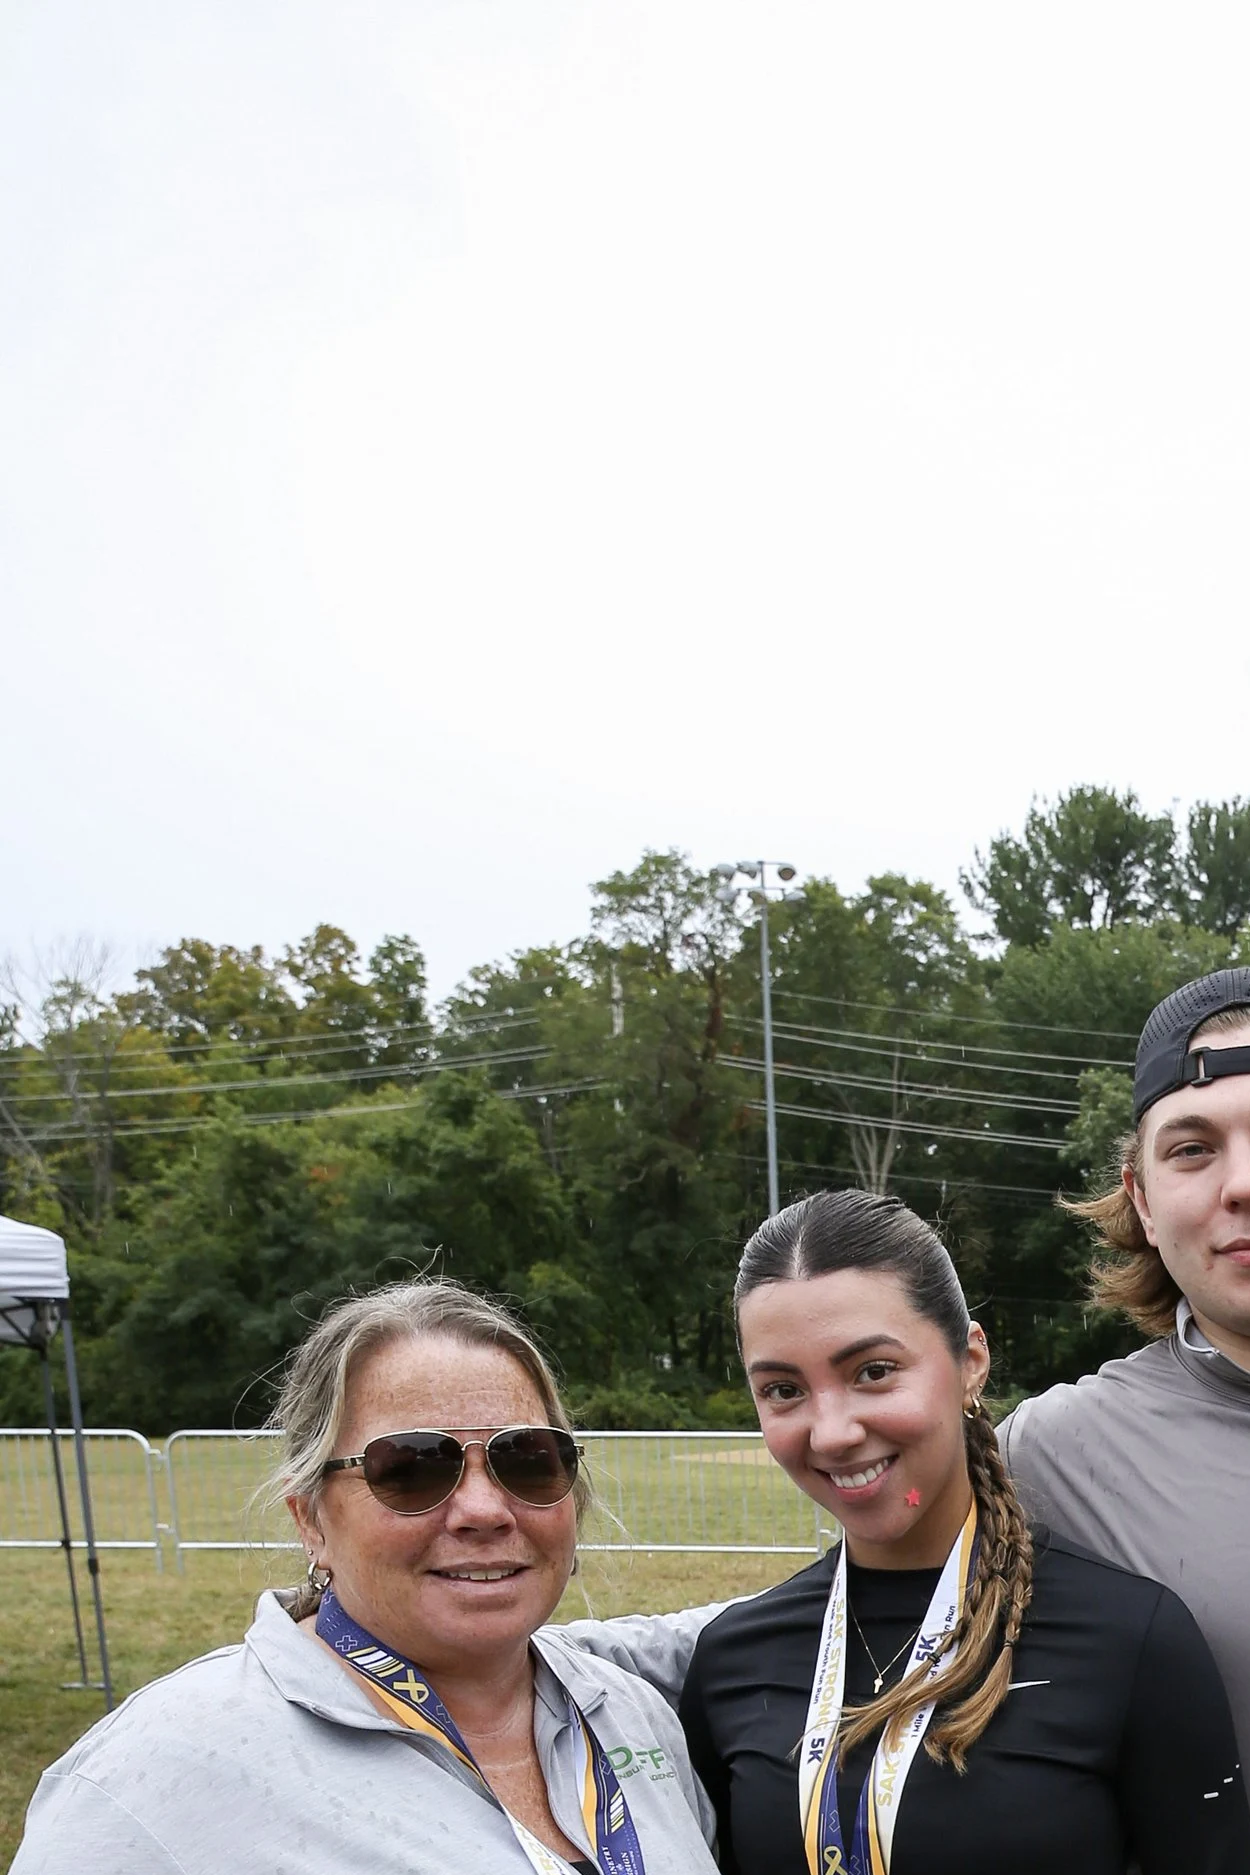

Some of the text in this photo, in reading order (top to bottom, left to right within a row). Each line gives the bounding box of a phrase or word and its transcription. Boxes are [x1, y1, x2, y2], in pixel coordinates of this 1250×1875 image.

[834, 1598, 844, 1643] SAK
[945, 1605, 956, 1622] Run
[822, 1642, 832, 1668] Youth
[915, 1634, 937, 1662] 5K
[818, 1668, 827, 1686] Fun
[813, 1687, 822, 1704] Run
[914, 1714, 924, 1732] Mile
[808, 1738, 826, 1764] 5K
[877, 1759, 898, 1808] SAK
